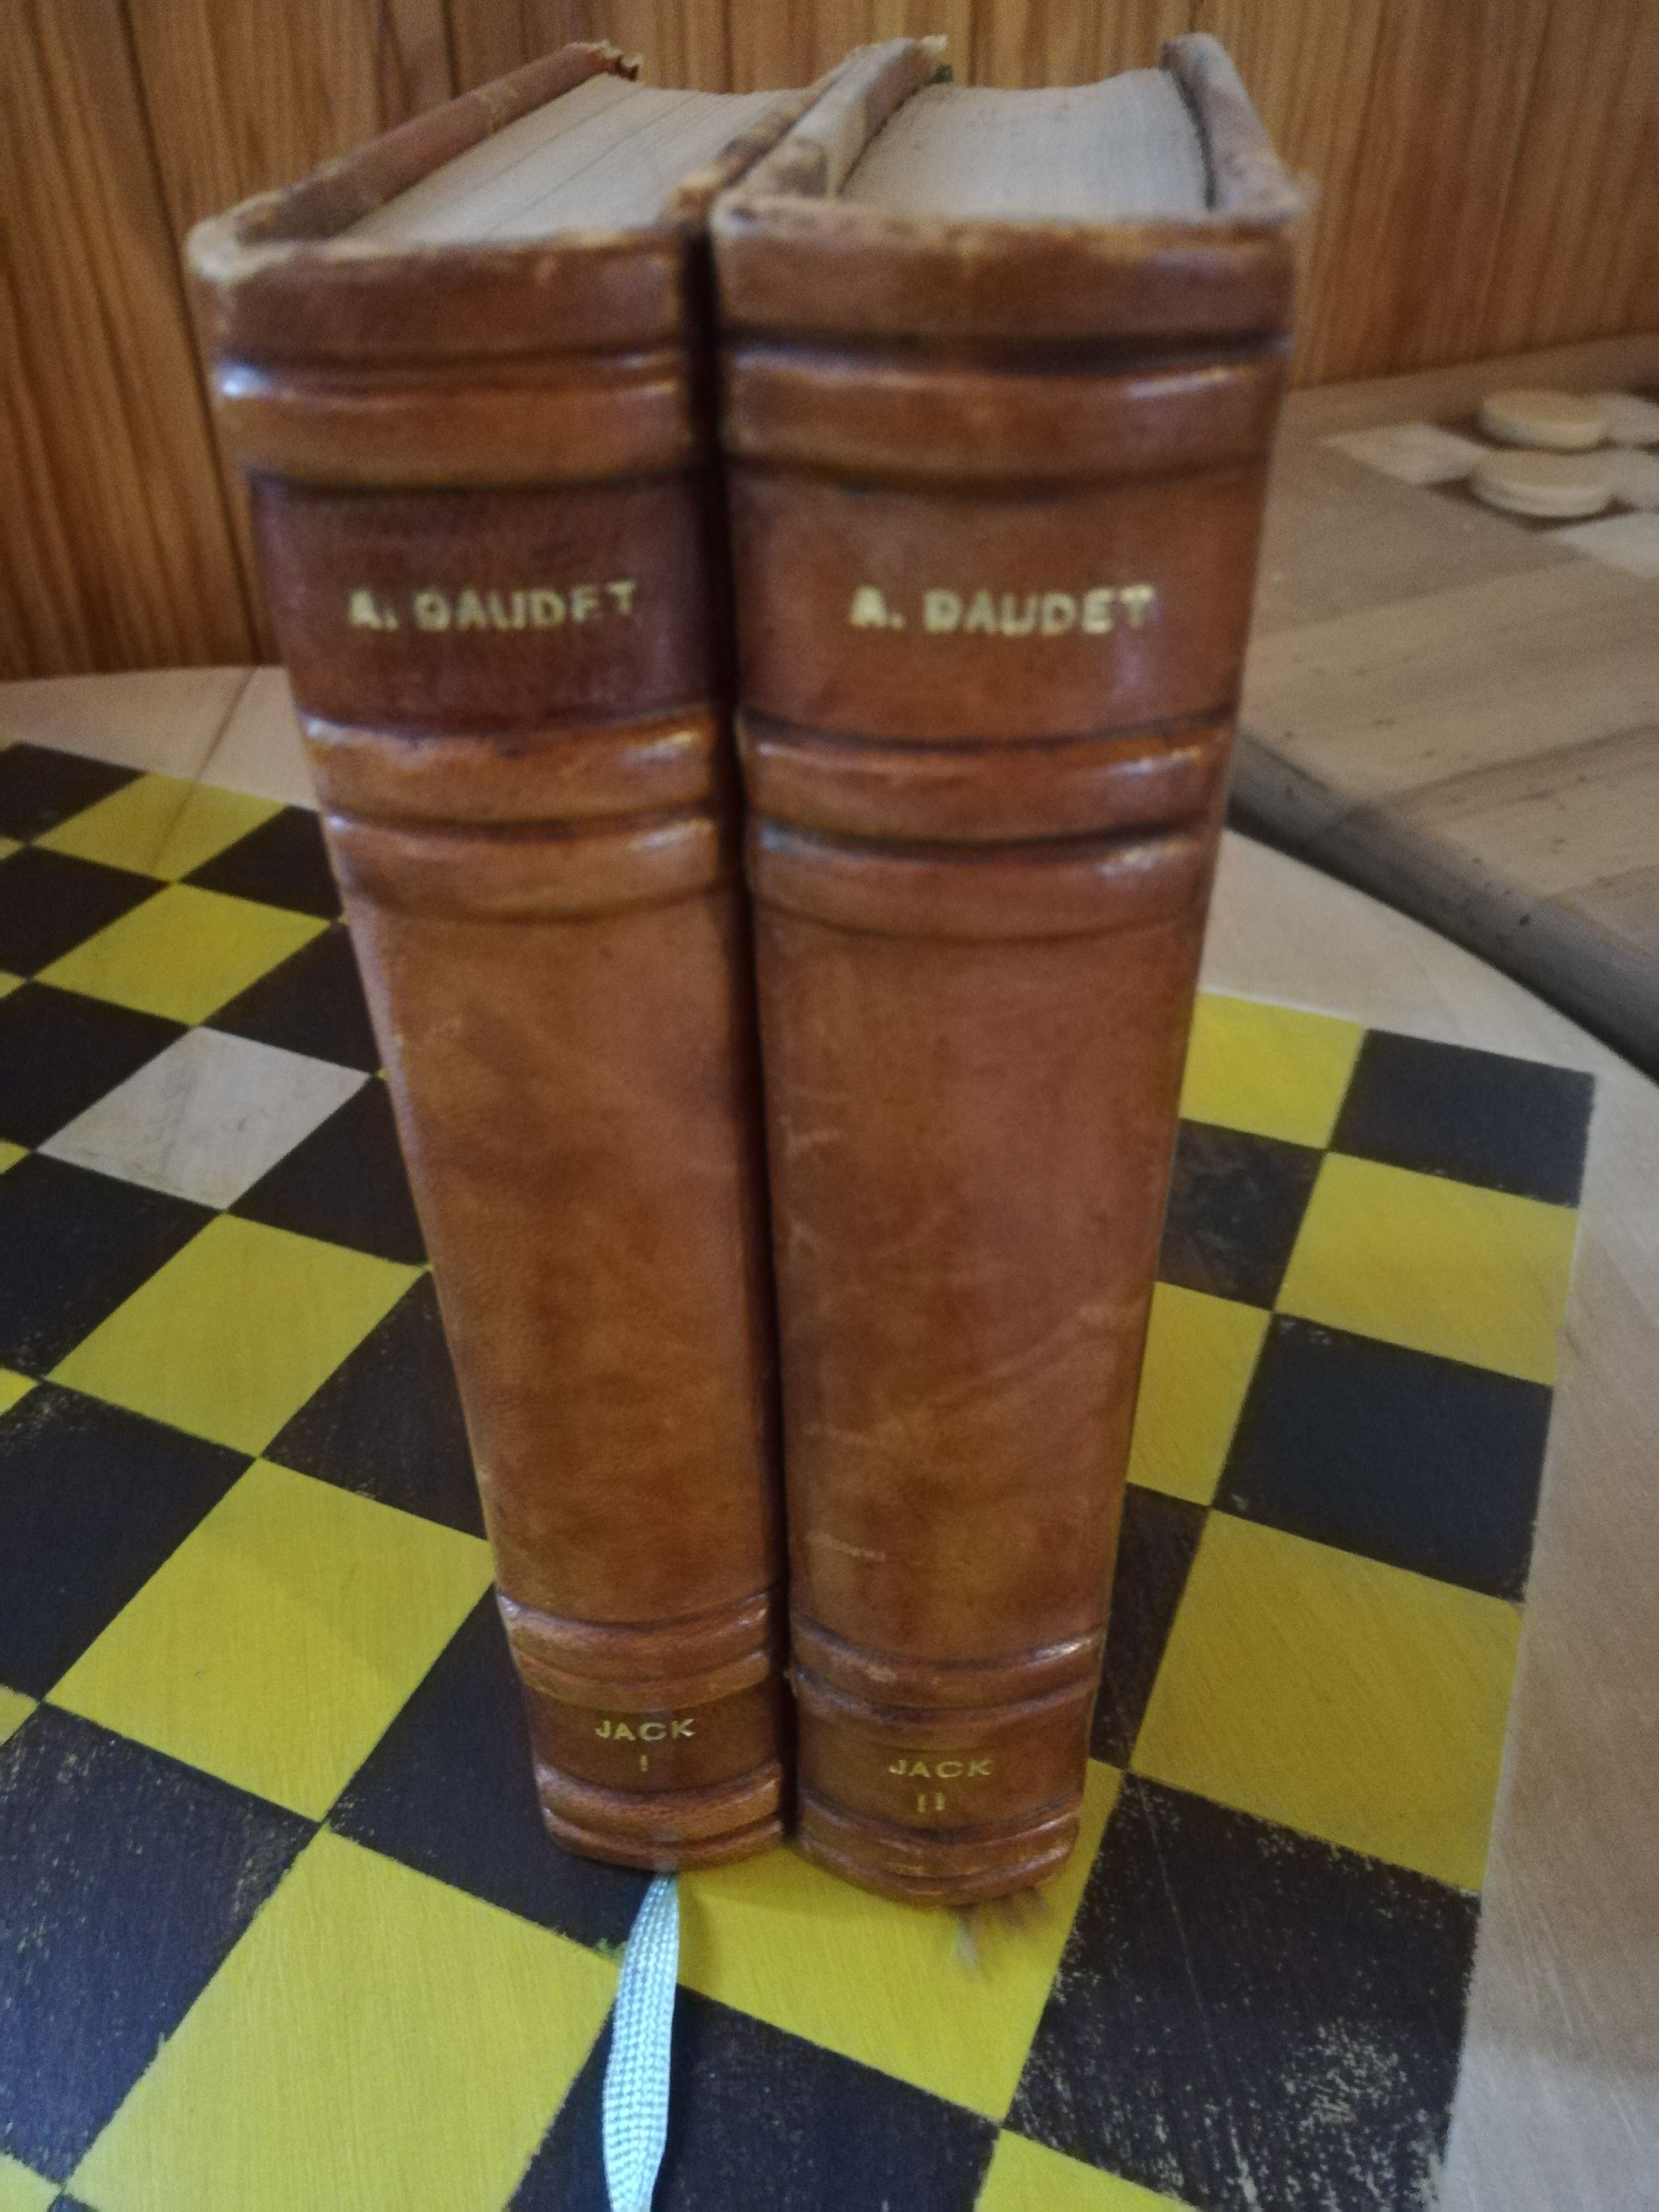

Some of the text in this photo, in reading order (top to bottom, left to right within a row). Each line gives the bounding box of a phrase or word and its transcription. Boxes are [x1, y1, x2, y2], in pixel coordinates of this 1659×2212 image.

[850, 582, 1154, 637] A. DAUDET
[595, 1719, 696, 1741] JACK
[889, 1758, 993, 1778] JACK
